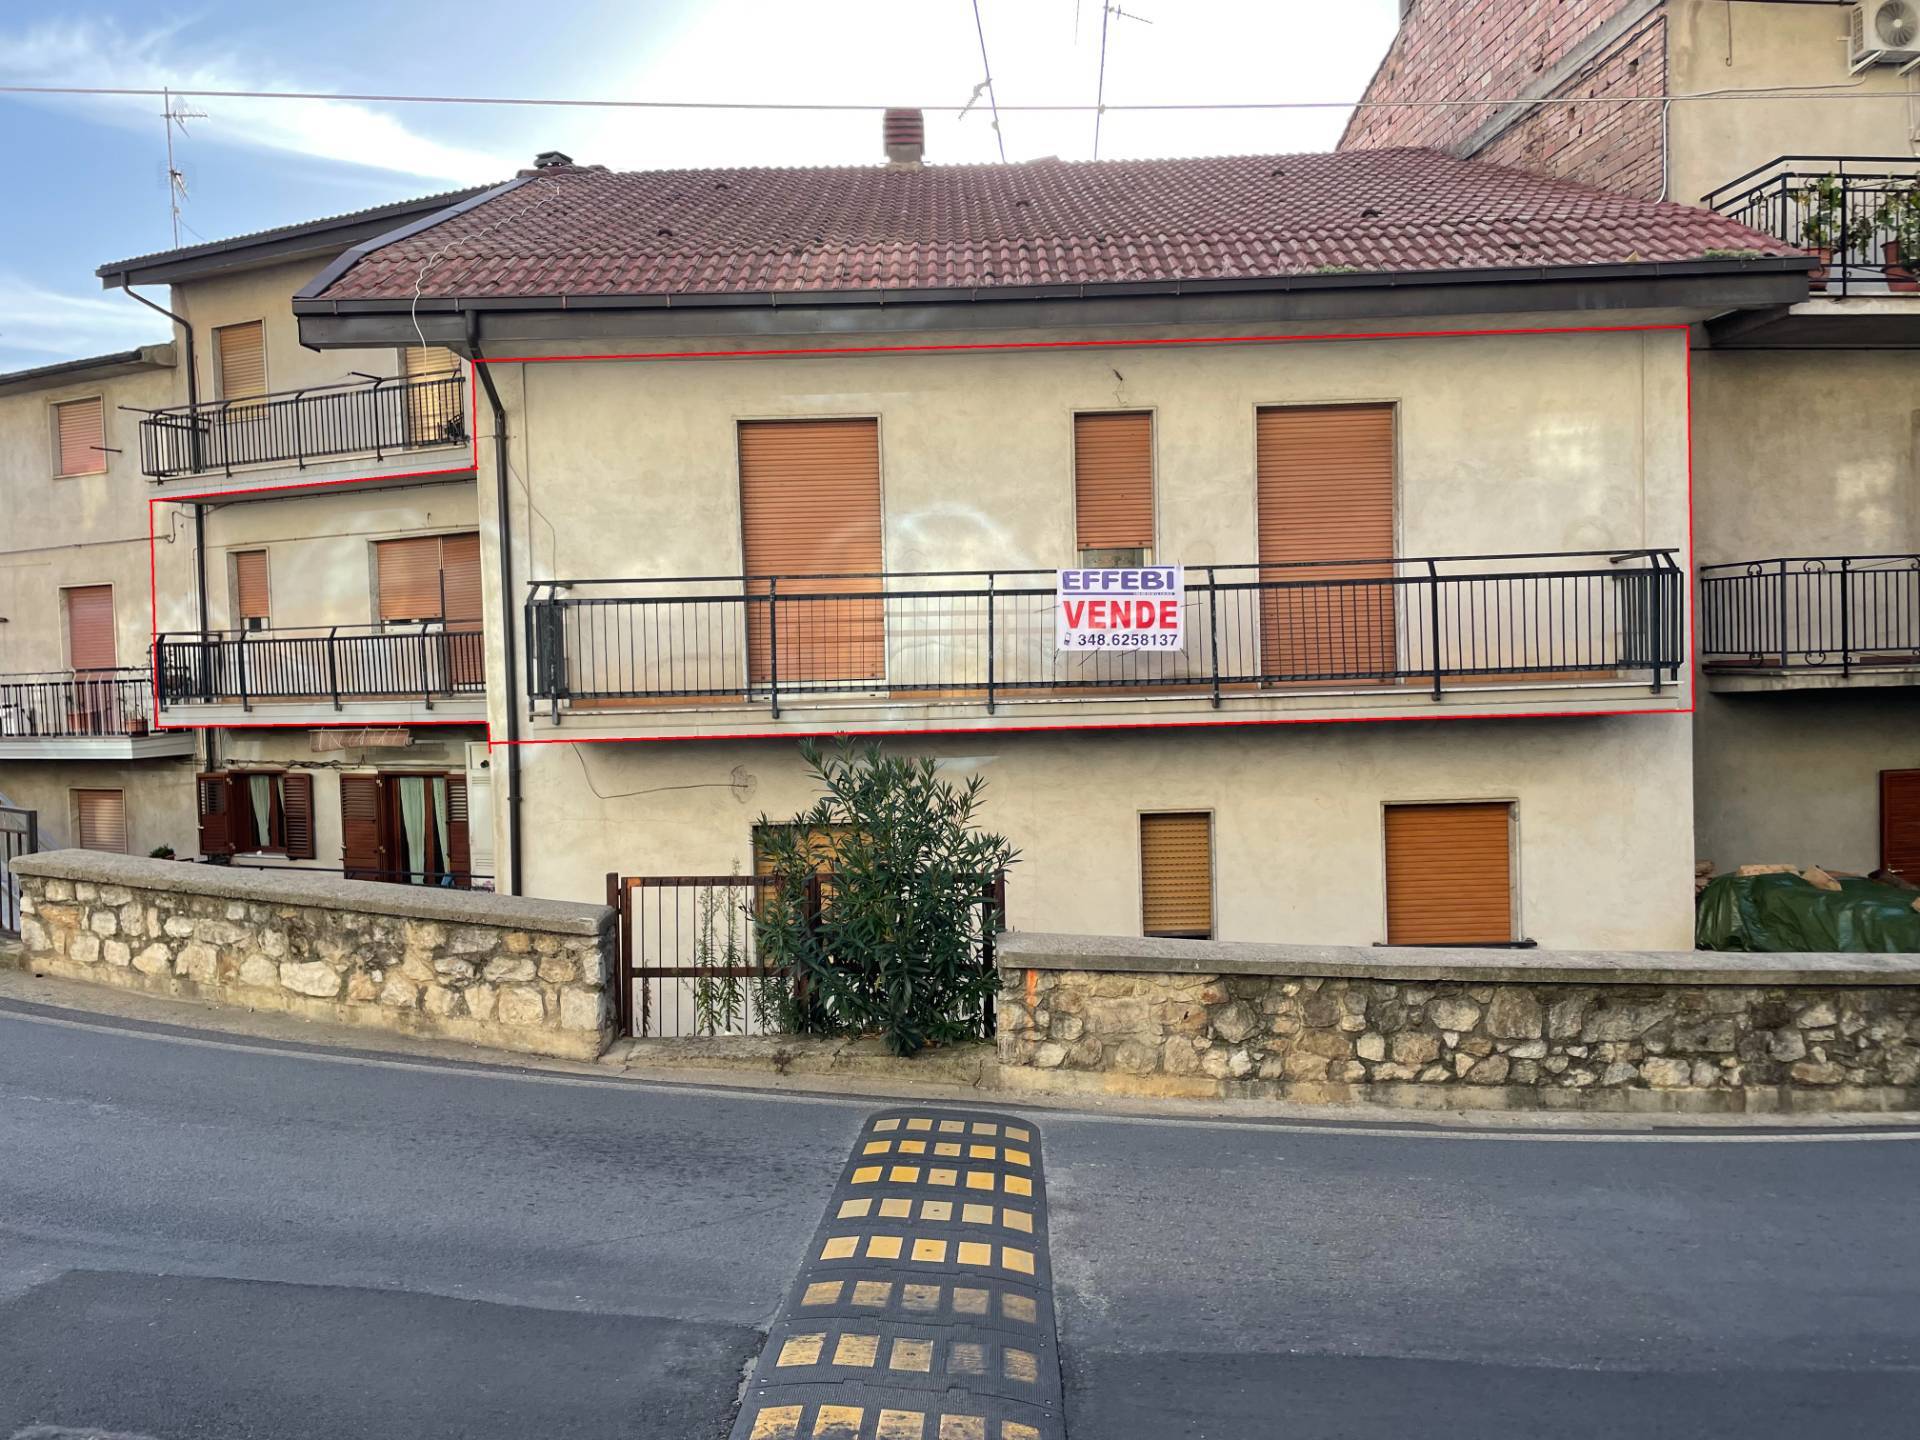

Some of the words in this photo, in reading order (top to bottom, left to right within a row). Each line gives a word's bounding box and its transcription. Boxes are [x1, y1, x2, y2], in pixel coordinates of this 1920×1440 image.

[1062, 570, 1175, 590] EFFEBI
[1063, 600, 1178, 630] VENDE
[1078, 633, 1178, 647] 348.6258137
